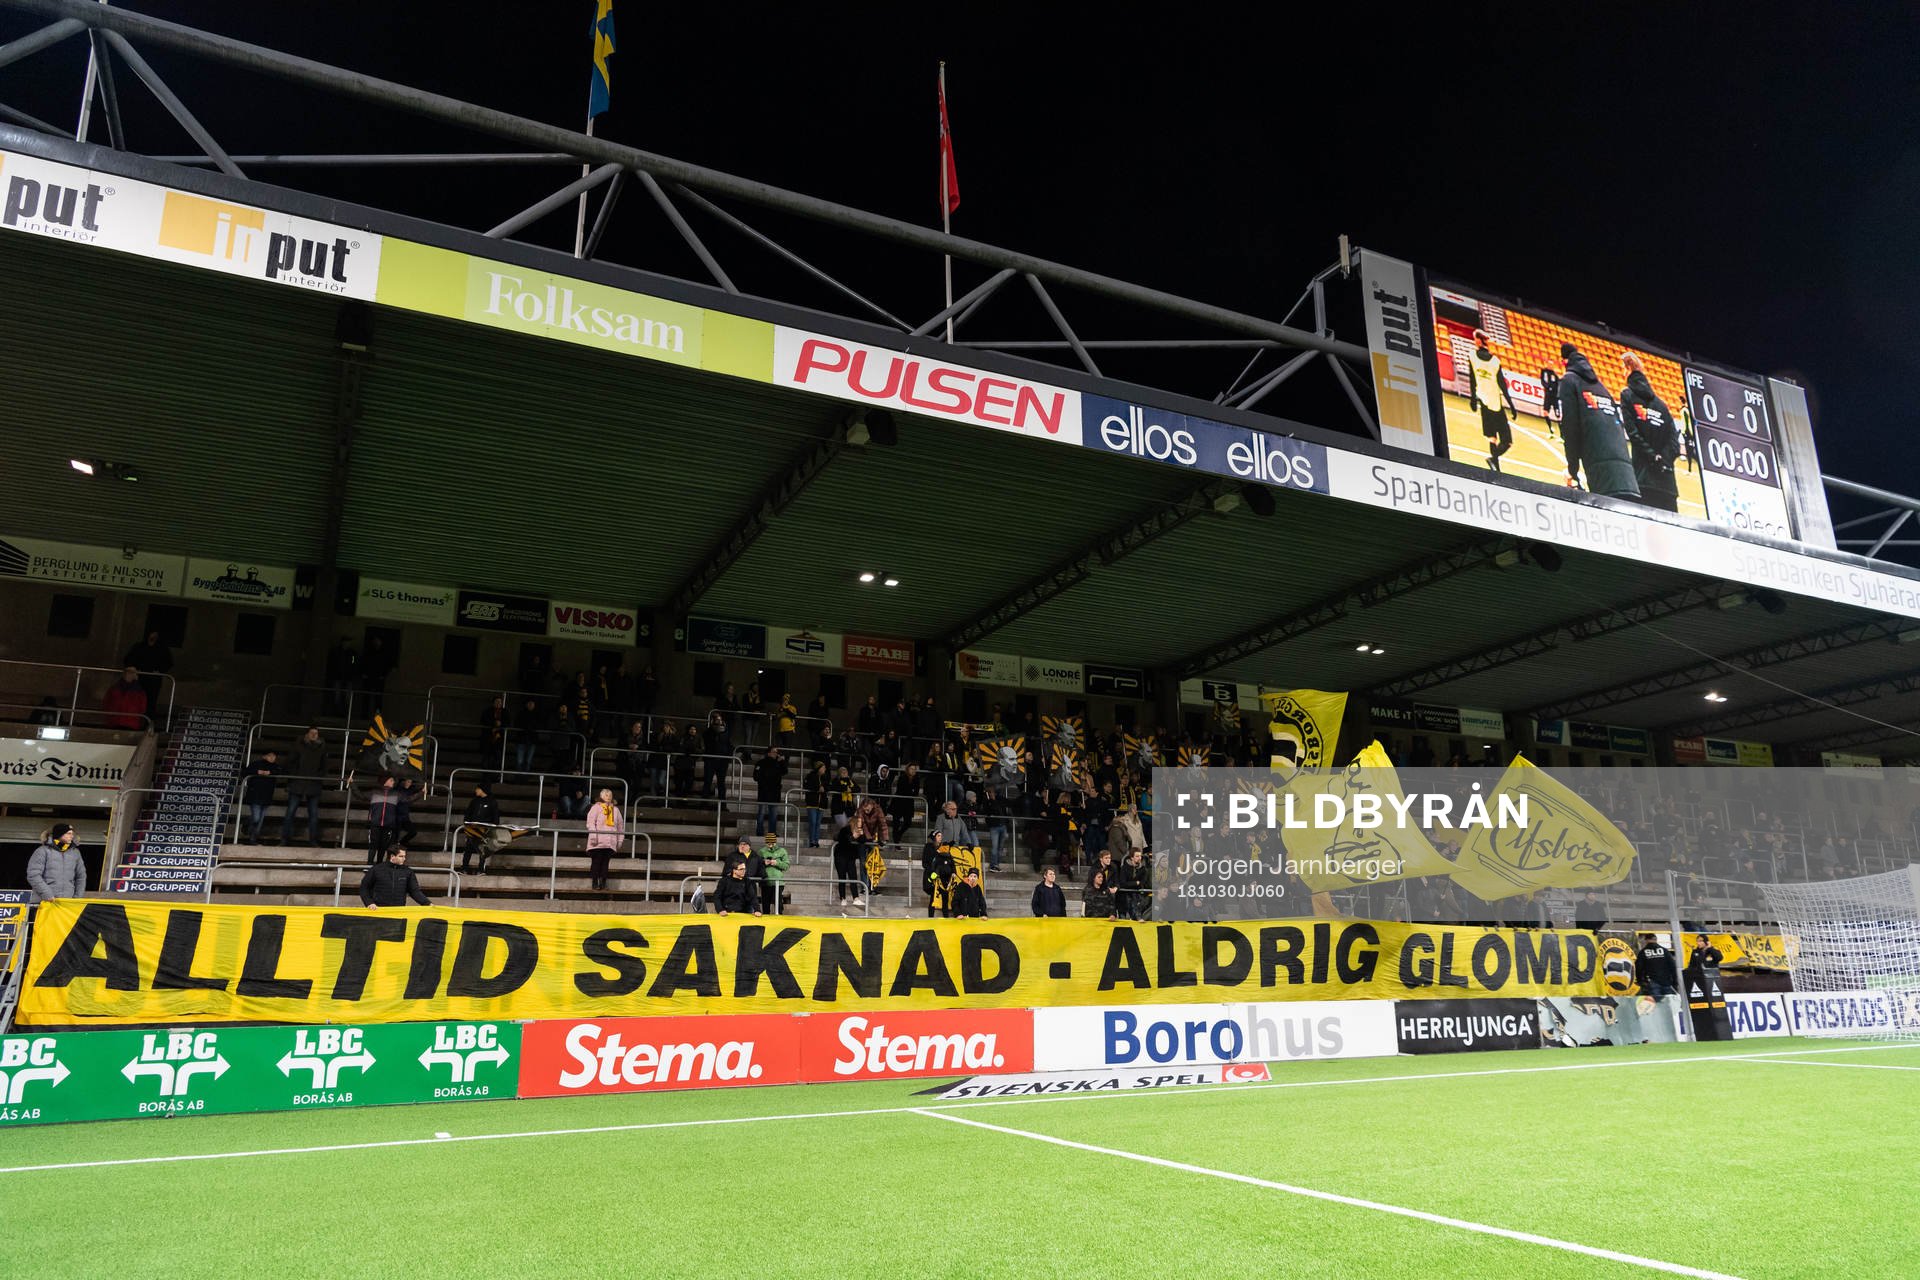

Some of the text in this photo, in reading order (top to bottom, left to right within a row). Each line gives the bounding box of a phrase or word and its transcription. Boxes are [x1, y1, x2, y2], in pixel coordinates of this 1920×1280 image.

[23, 220, 97, 242] interiör
[282, 271, 347, 294] interiör
[483, 271, 684, 353] Folksam
[793, 339, 1065, 434] PULSEN
[1688, 372, 1704, 390] IFE
[1744, 390, 1764, 407] DFF
[1101, 405, 1197, 465] ellos
[1226, 432, 1314, 489] ellos
[1708, 438, 1769, 480] 00:00
[1372, 466, 1639, 552] Sparbanken Sjuhärad
[32, 568, 162, 588] FASTIGHETER AB
[33, 557, 99, 573] BERGLUND
[113, 566, 164, 580] NILSSON
[1733, 546, 1846, 594] Sparbanken
[372, 589, 445, 606] SLG thomas
[554, 607, 634, 631] VISKO
[1370, 707, 1400, 719] MAKE
[174, 777, 230, 785] RO-GRUPPEN
[142, 856, 207, 866] RO-GRUPPEN
[147, 845, 210, 854] RO-GRUPPEN
[136, 870, 203, 879] RO-GRUPPEN
[131, 883, 200, 892] RO-GRUPPEN
[34, 904, 1597, 1001] ALLTID SAKNAD - ALDRIG GLOMD
[1644, 947, 1665, 958] SLO
[1792, 997, 1889, 1030] FRISTADS
[294, 1028, 363, 1056] LBC
[434, 1024, 498, 1050] LBC
[834, 1016, 1004, 1075] Stema.
[1104, 1005, 1344, 1065] Borohus
[141, 1033, 217, 1061] LBC
[559, 1024, 763, 1088] Stema.
[434, 1085, 489, 1097] BORÅS AB
[946, 1073, 1213, 1099] SVENSKA SPEL
[138, 1098, 204, 1113] BORÅS AB
[293, 1091, 353, 1105] BORÅS AB
[21, 1109, 41, 1120] AB
